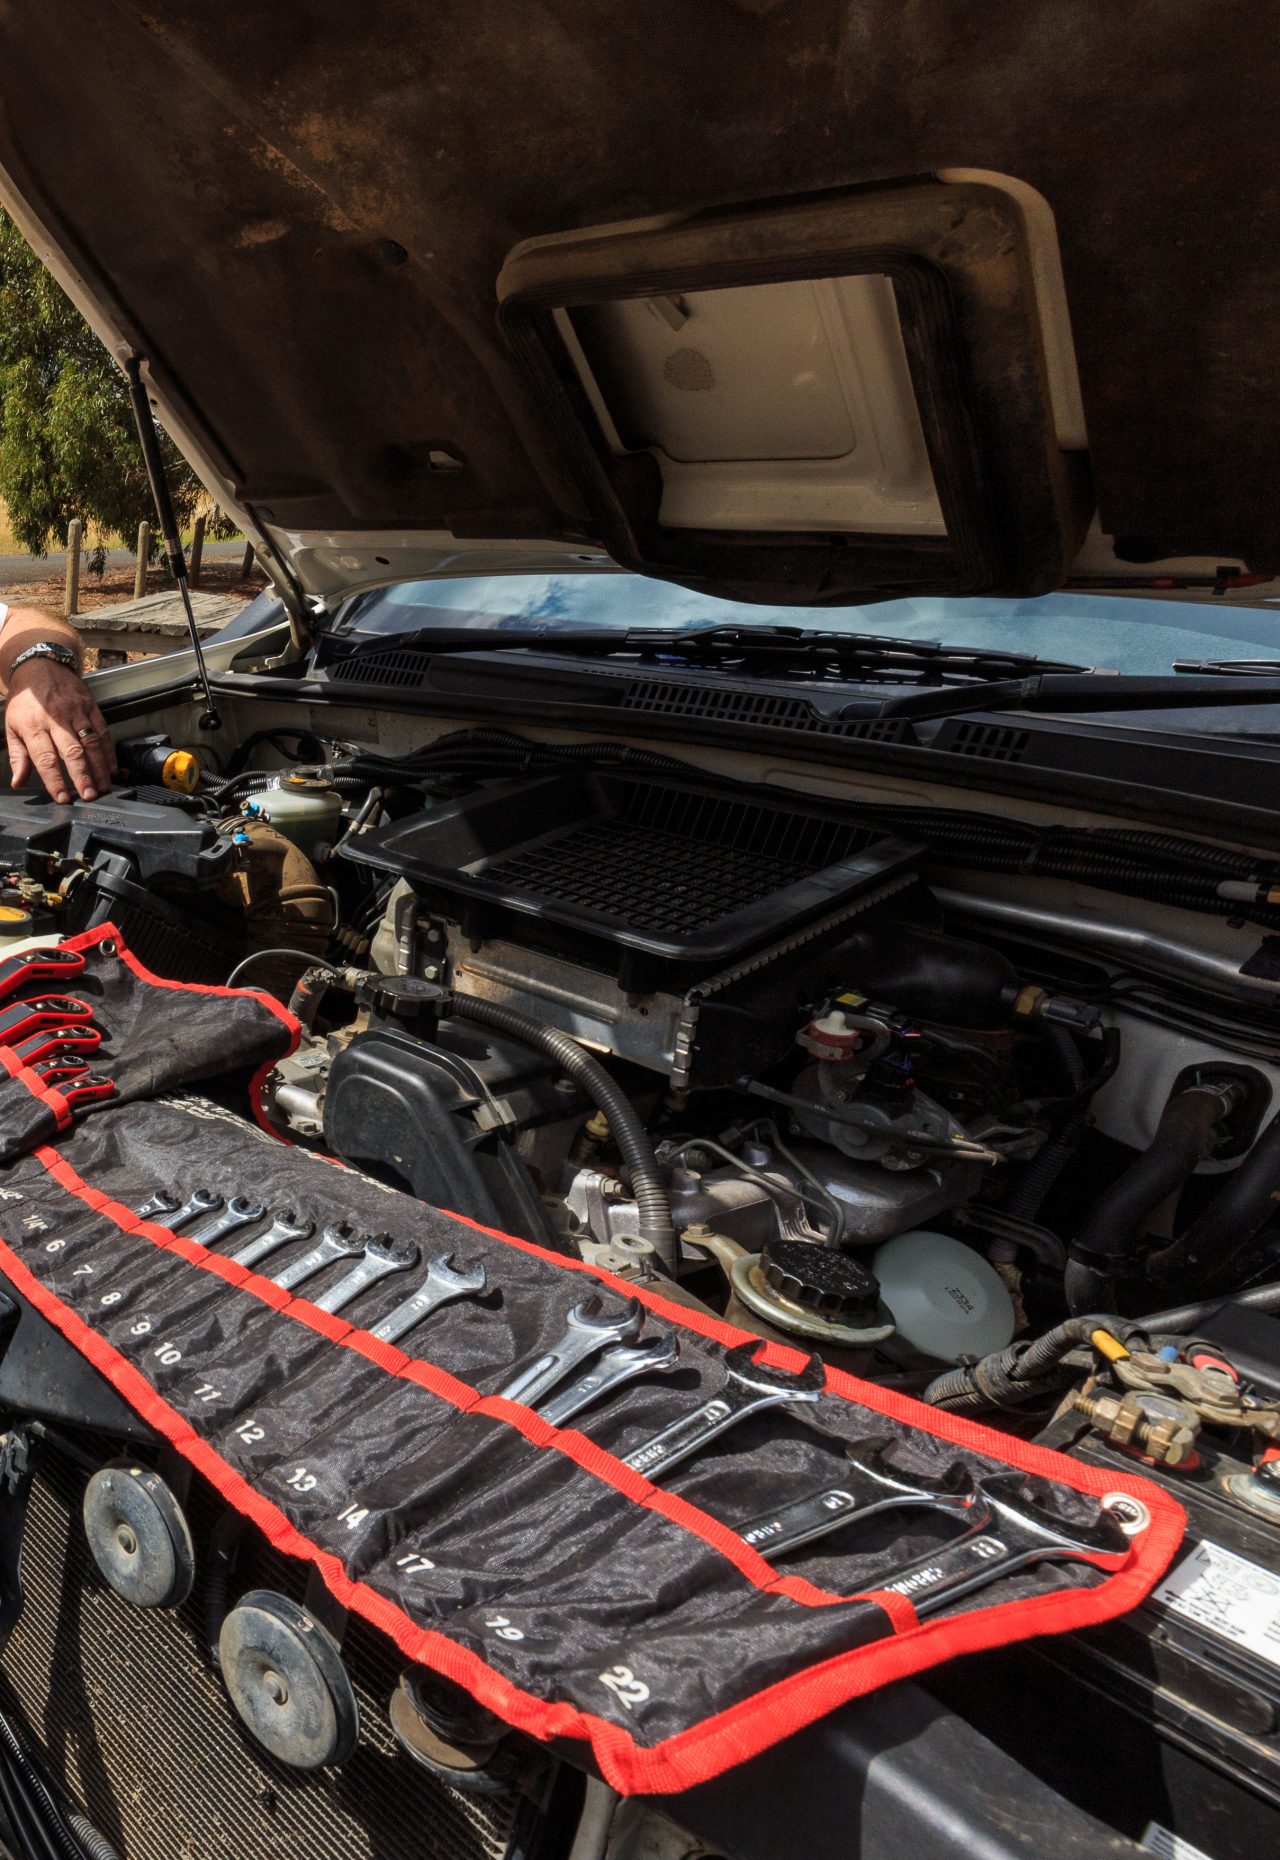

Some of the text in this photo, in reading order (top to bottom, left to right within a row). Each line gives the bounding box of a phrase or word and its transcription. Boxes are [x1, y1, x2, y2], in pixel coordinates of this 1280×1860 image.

[46, 1240, 66, 1253] 6
[73, 1264, 94, 1276] 7
[101, 1291, 122, 1306] 8
[131, 1321, 151, 1336] 9
[154, 1342, 182, 1365] 10
[193, 1383, 222, 1402] 11
[235, 1419, 265, 1444] 12
[286, 1468, 317, 1492] 13
[336, 1503, 370, 1530] 14
[396, 1553, 435, 1574] 17
[485, 1616, 525, 1641] 19
[598, 1665, 650, 1710] 22
